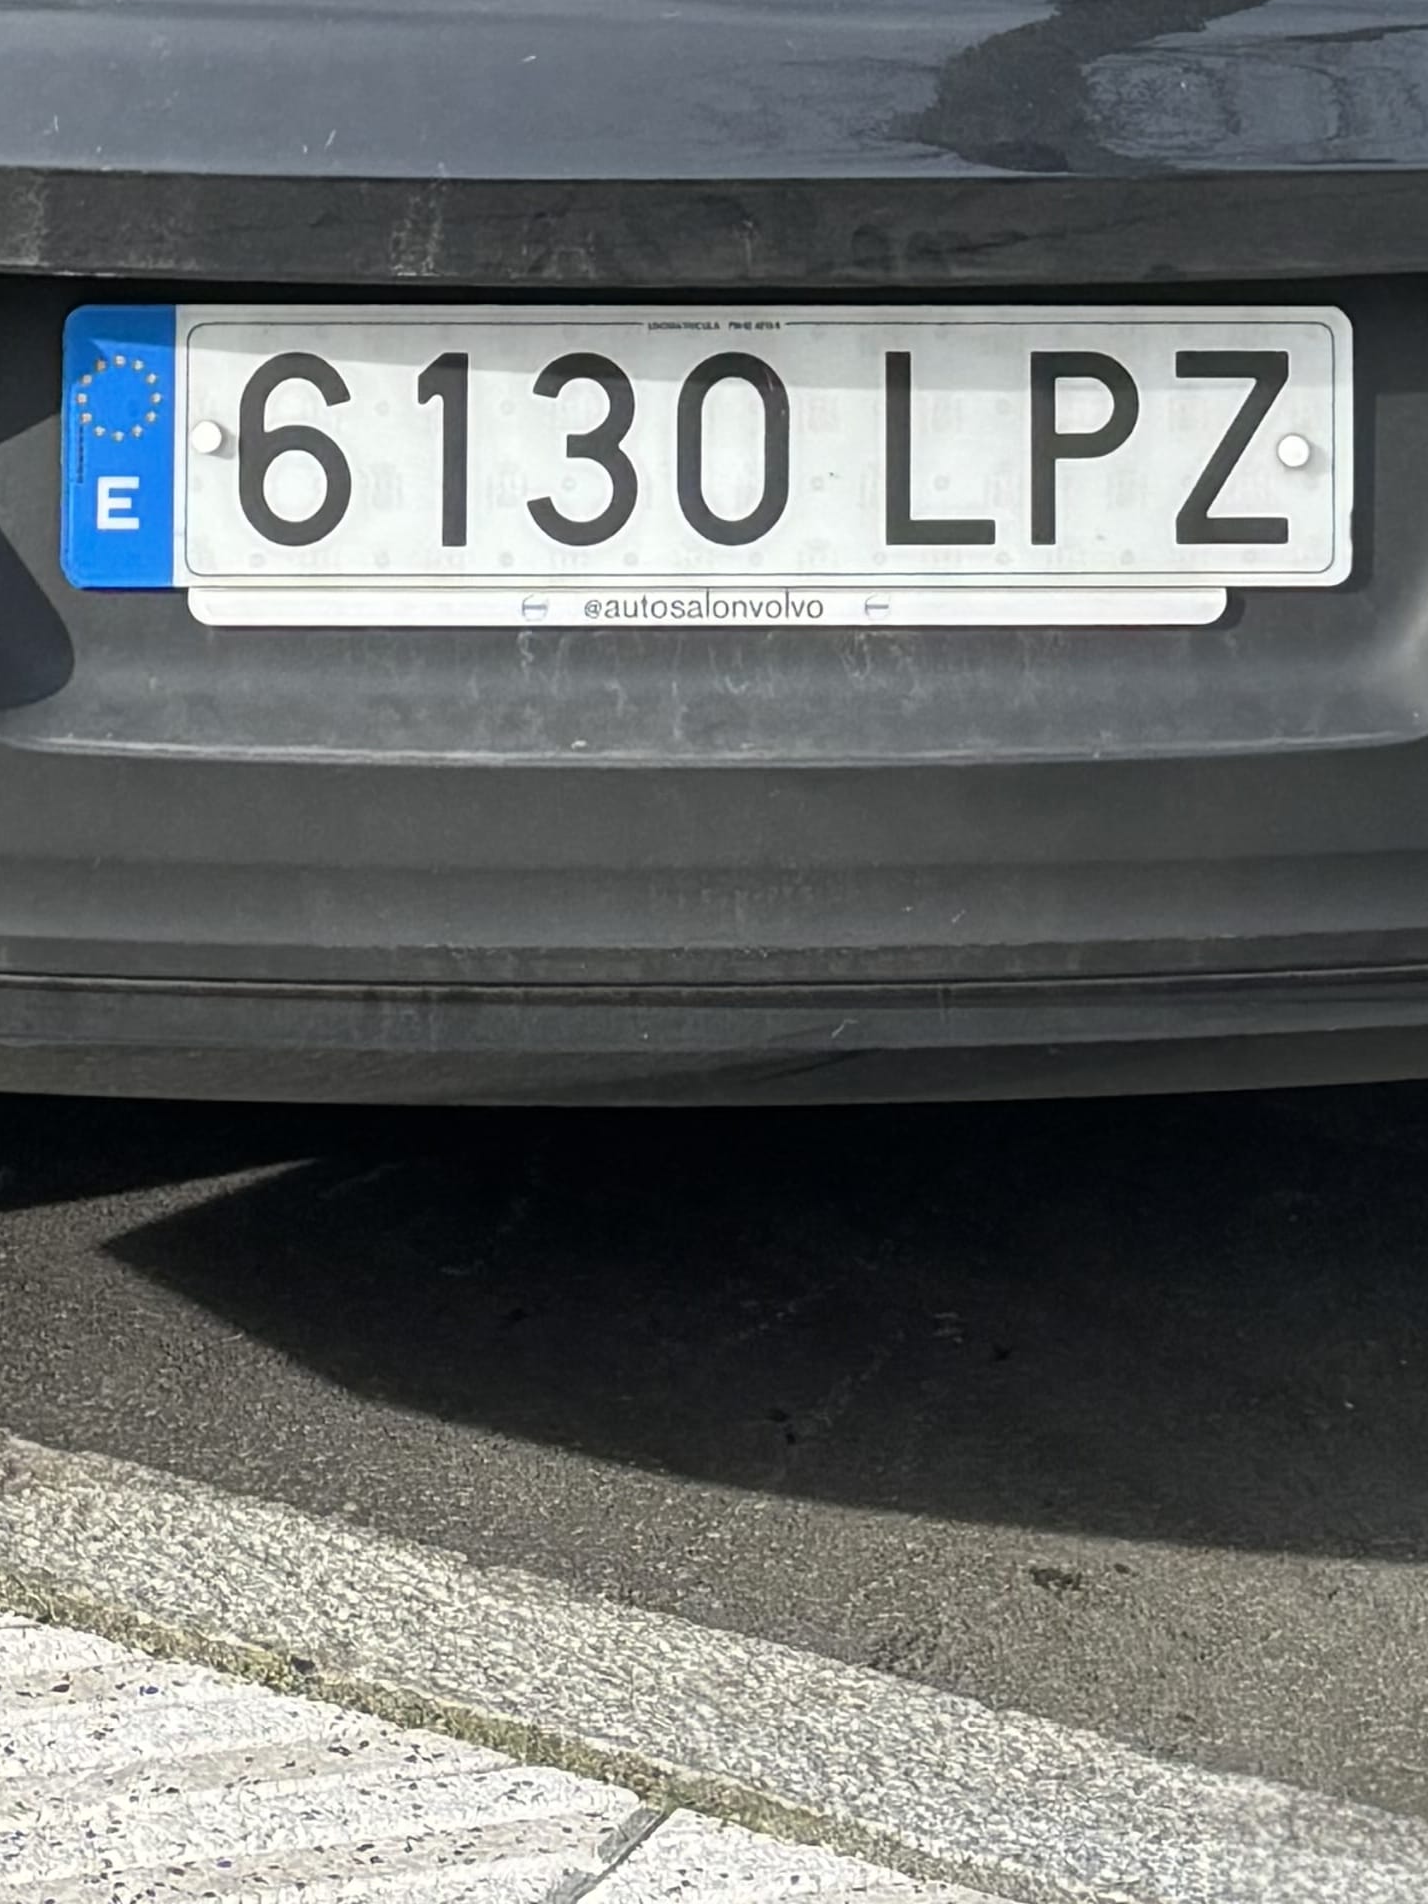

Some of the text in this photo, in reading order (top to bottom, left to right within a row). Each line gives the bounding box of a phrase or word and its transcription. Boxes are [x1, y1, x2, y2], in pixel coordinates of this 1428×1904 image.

[237, 349, 1294, 548] 6130 LPZ
[97, 476, 139, 530] E
[584, 589, 824, 619] @autosalonvolvo
